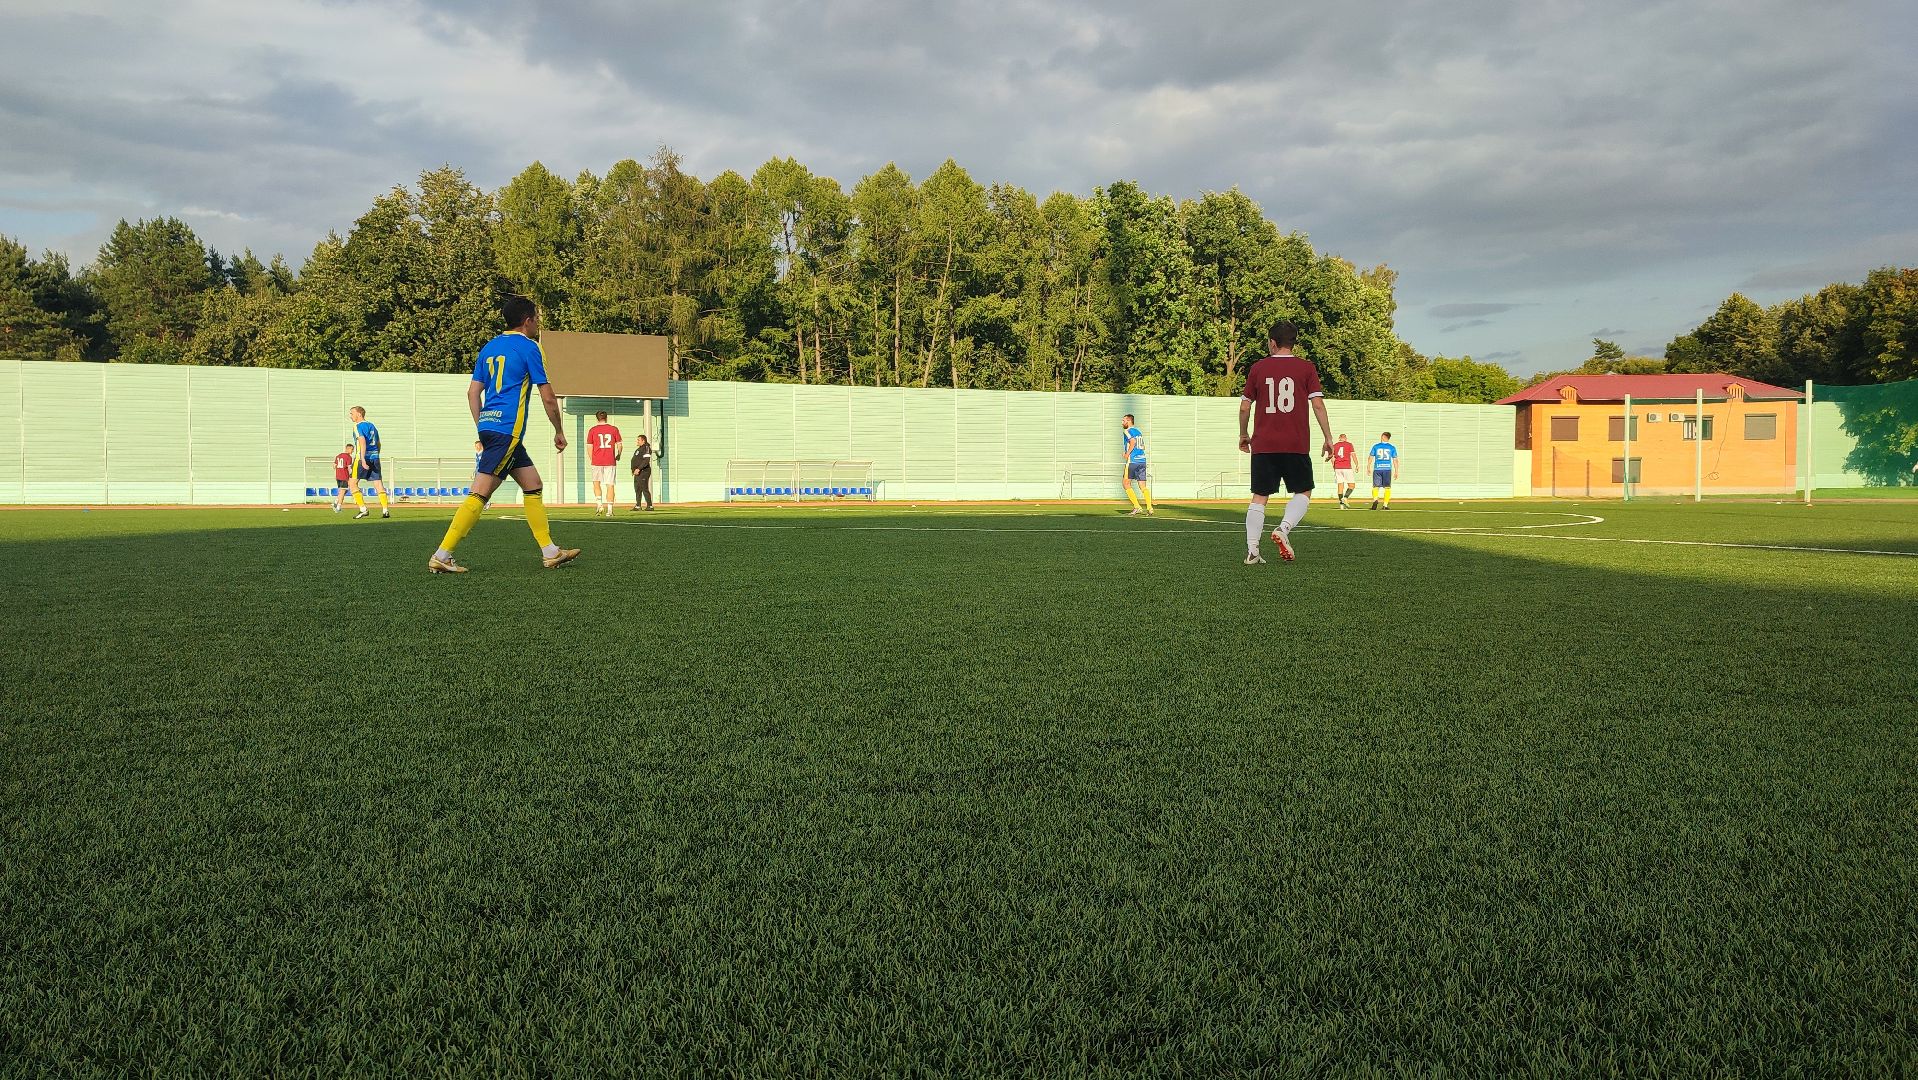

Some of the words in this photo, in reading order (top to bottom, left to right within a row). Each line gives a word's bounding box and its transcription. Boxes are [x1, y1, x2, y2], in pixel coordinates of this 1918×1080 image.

[486, 355, 506, 394] 11
[1265, 376, 1295, 414] 18
[598, 433, 612, 449] 12
[1135, 435, 1145, 450] 10
[1337, 446, 1345, 459] 4
[1376, 448, 1391, 461] 95
[336, 457, 344, 469] 10
